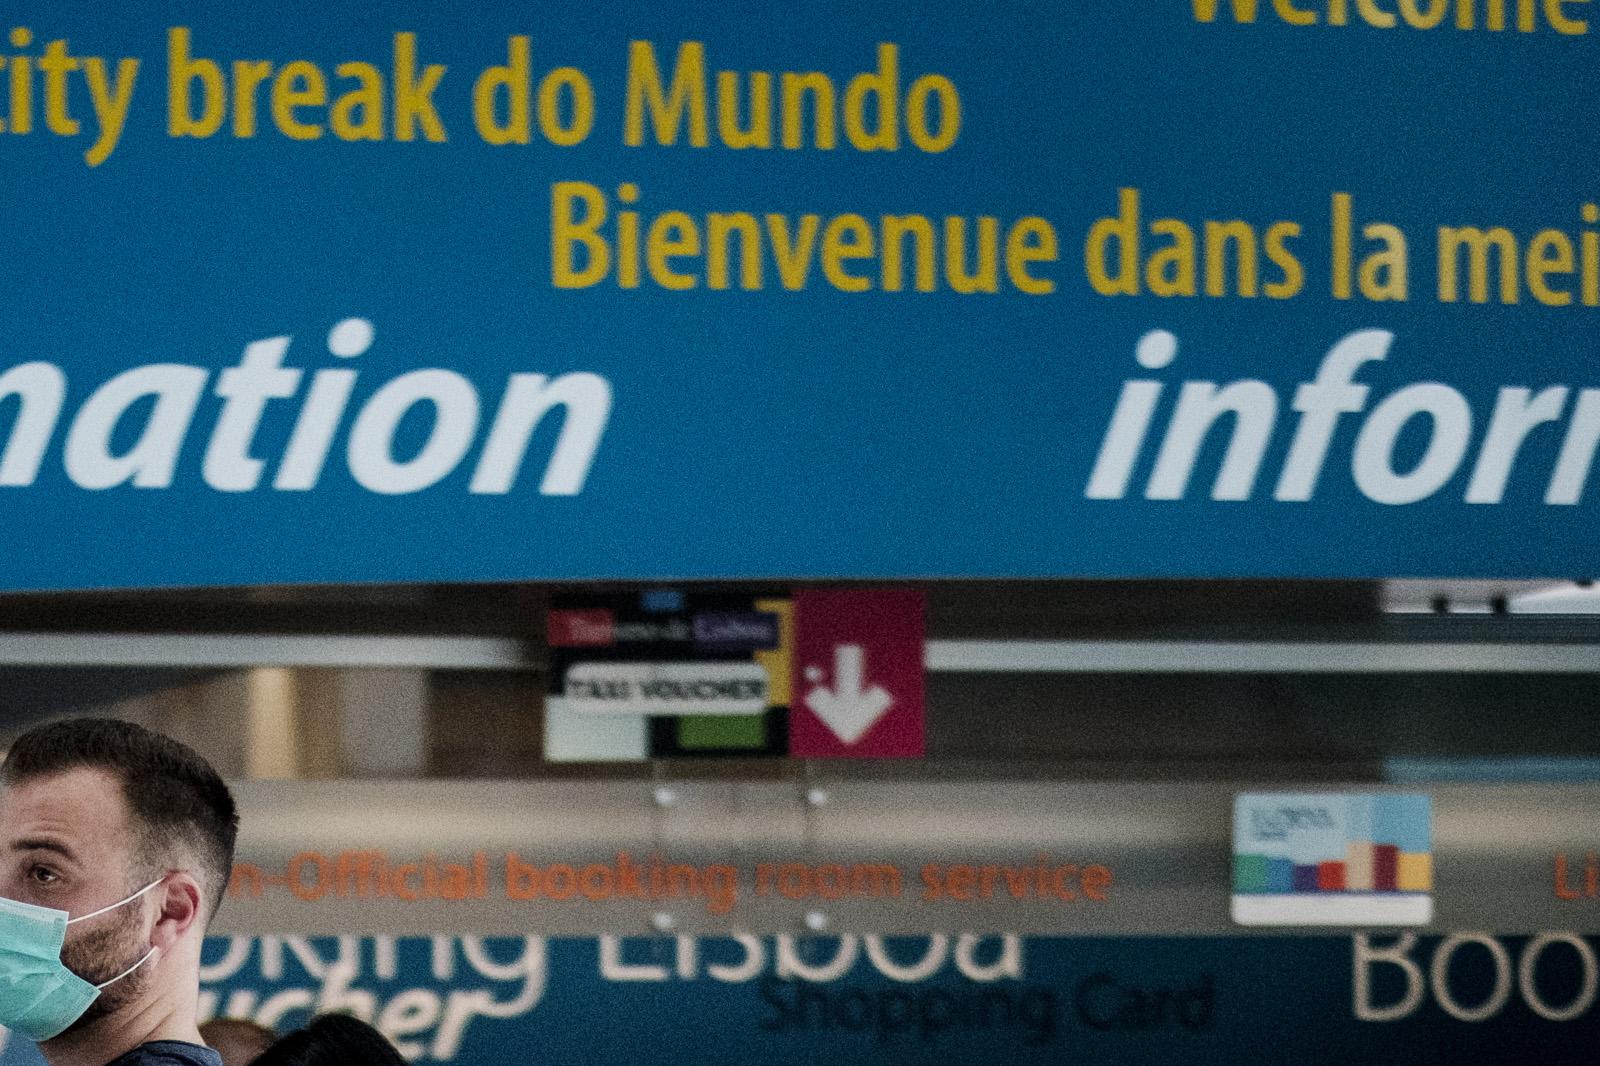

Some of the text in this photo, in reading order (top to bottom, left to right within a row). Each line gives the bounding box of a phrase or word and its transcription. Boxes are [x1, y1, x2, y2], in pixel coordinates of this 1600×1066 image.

[167, 26, 448, 143] break
[472, 34, 595, 147] do
[623, 39, 962, 154] Mundo
[550, 181, 1600, 307] Bienvenue dans la mei
[503, 850, 739, 915] booking
[754, 861, 904, 901] room
[919, 855, 1115, 903] service
[1074, 971, 1215, 1032] Card
